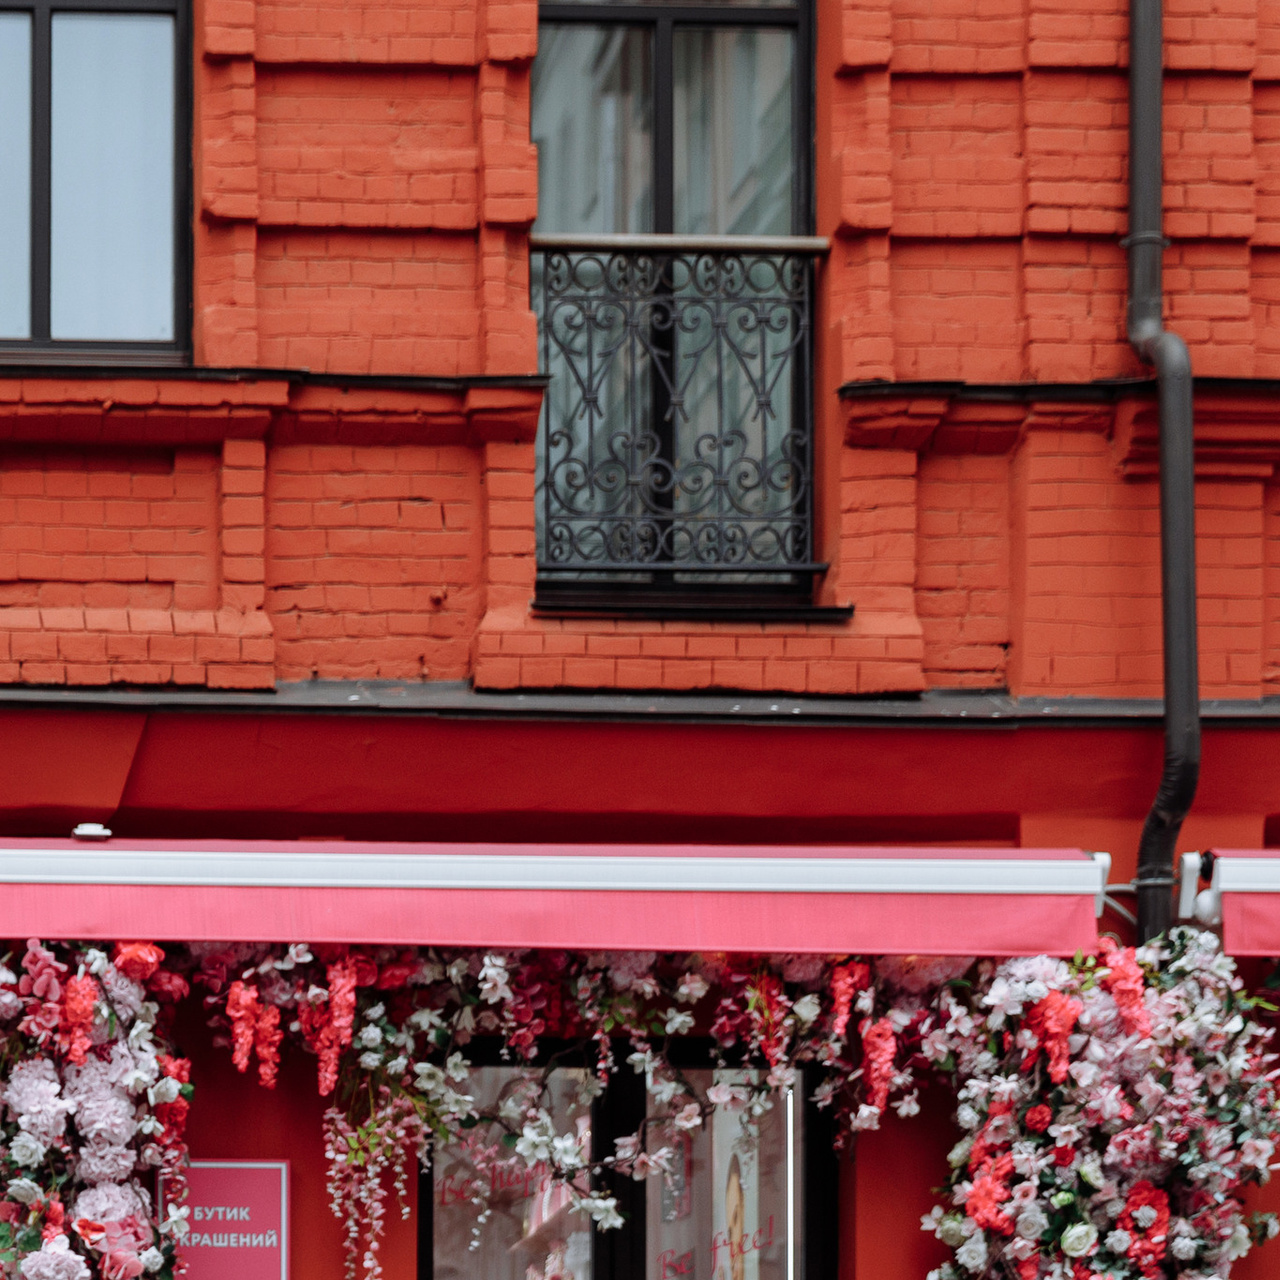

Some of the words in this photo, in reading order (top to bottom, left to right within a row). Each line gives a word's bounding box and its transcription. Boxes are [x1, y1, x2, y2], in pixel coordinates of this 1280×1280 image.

[193, 1206, 251, 1221] БУТИК
[176, 1230, 278, 1248] КРАШЕНИЙ
[656, 1248, 695, 1280] Be
[709, 1213, 775, 1278] free!
